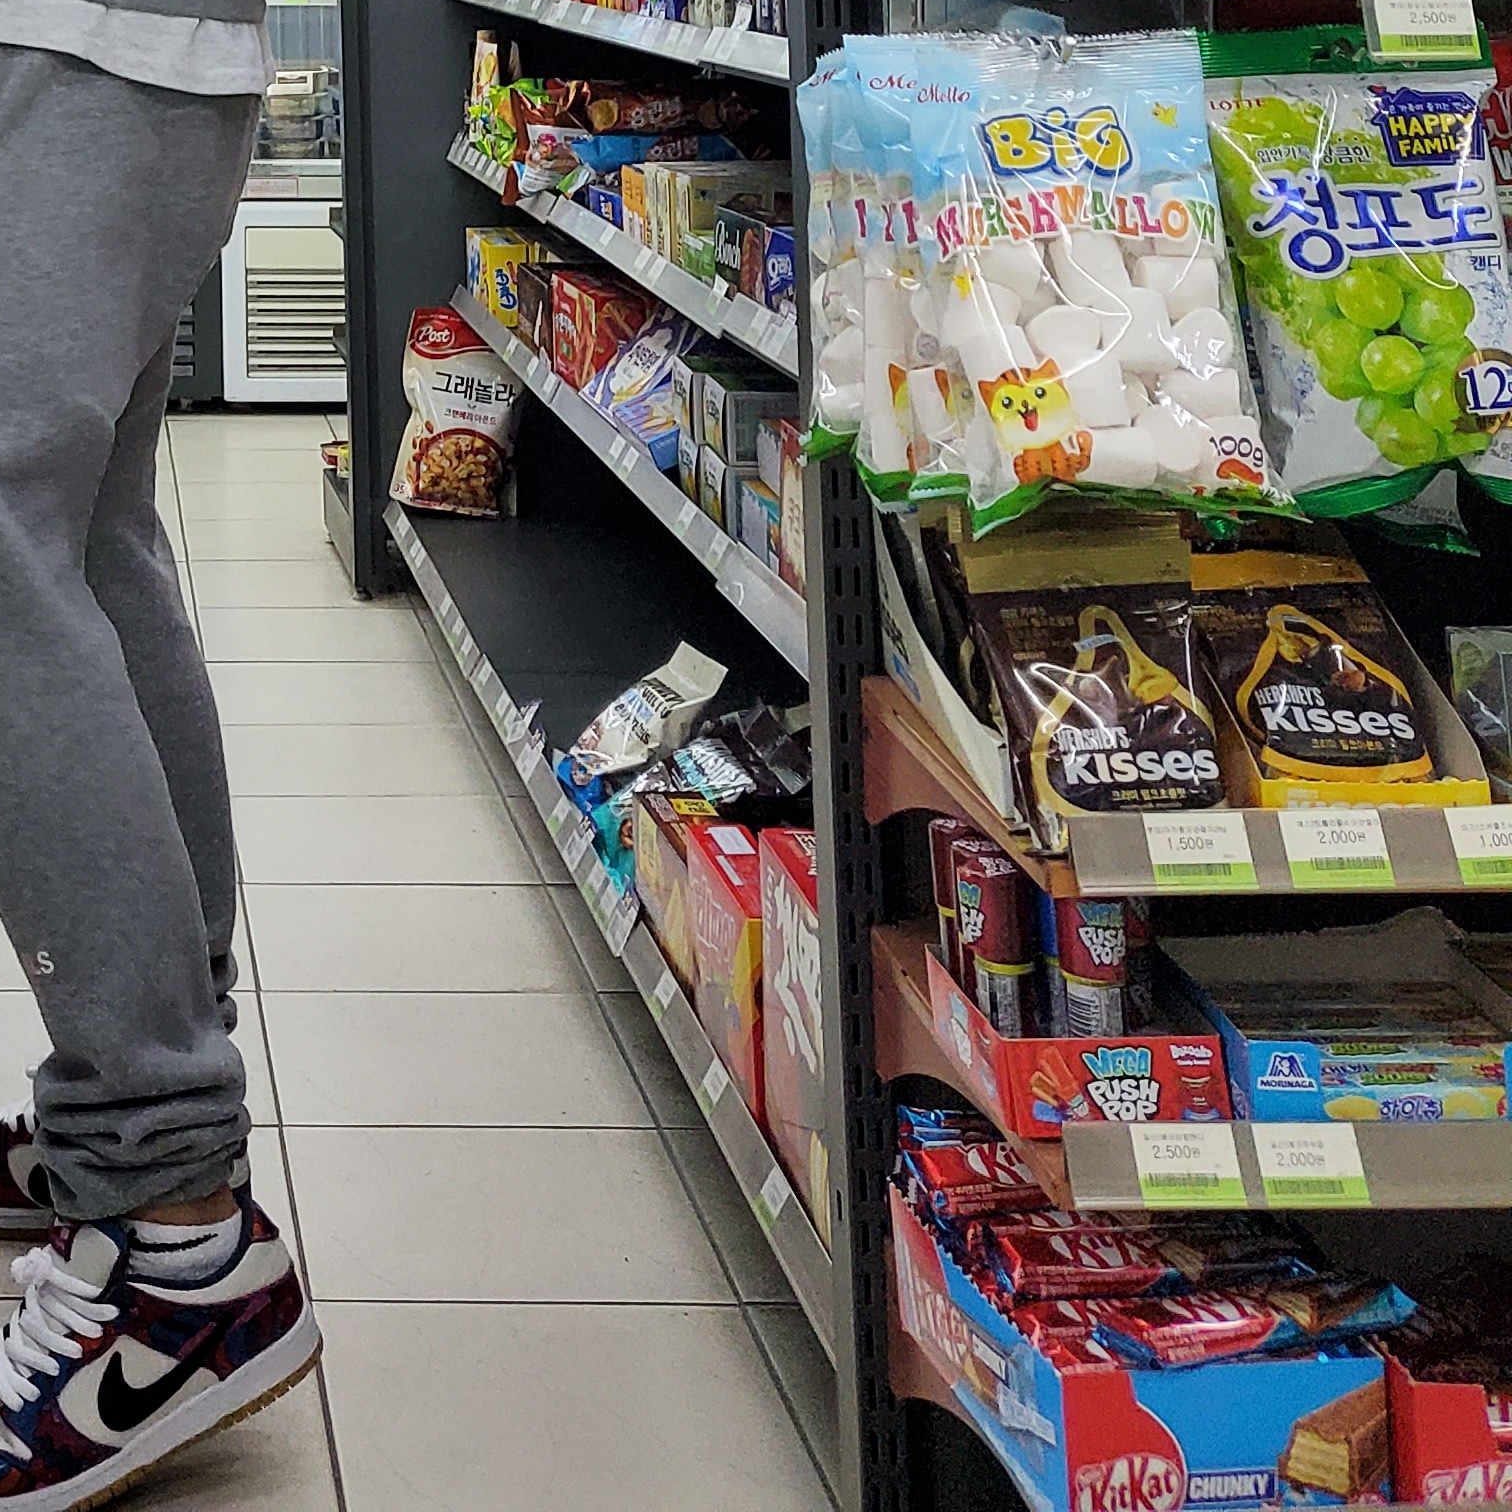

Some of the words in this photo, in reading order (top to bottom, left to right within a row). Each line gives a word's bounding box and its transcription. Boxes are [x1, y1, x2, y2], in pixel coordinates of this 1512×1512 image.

[1409, 10, 1457, 25] 2,500원
[1389, 112, 1475, 137] HAPPY
[933, 184, 1219, 260] MARSHMALLOW
[1251, 175, 1500, 277] 청포도
[1469, 252, 1503, 273] 캔디
[418, 324, 451, 344] Post
[431, 371, 517, 408] 그래놀라
[1207, 434, 1264, 468] 100g
[1255, 686, 1324, 708] HERSHEY'S
[1166, 837, 1215, 851] 1,500원
[1318, 830, 1368, 845] 2,000원
[1089, 942, 1126, 967] POP
[1081, 1045, 1152, 1080] MEGA
[1087, 1077, 1160, 1102] PUSH
[1259, 1078, 1315, 1090] MORINAGA
[1101, 1098, 1158, 1121] POP
[1152, 1144, 1201, 1161] 2,500원
[1276, 1152, 1326, 1168] 2,000원
[1188, 1471, 1270, 1502] CHUNKY
